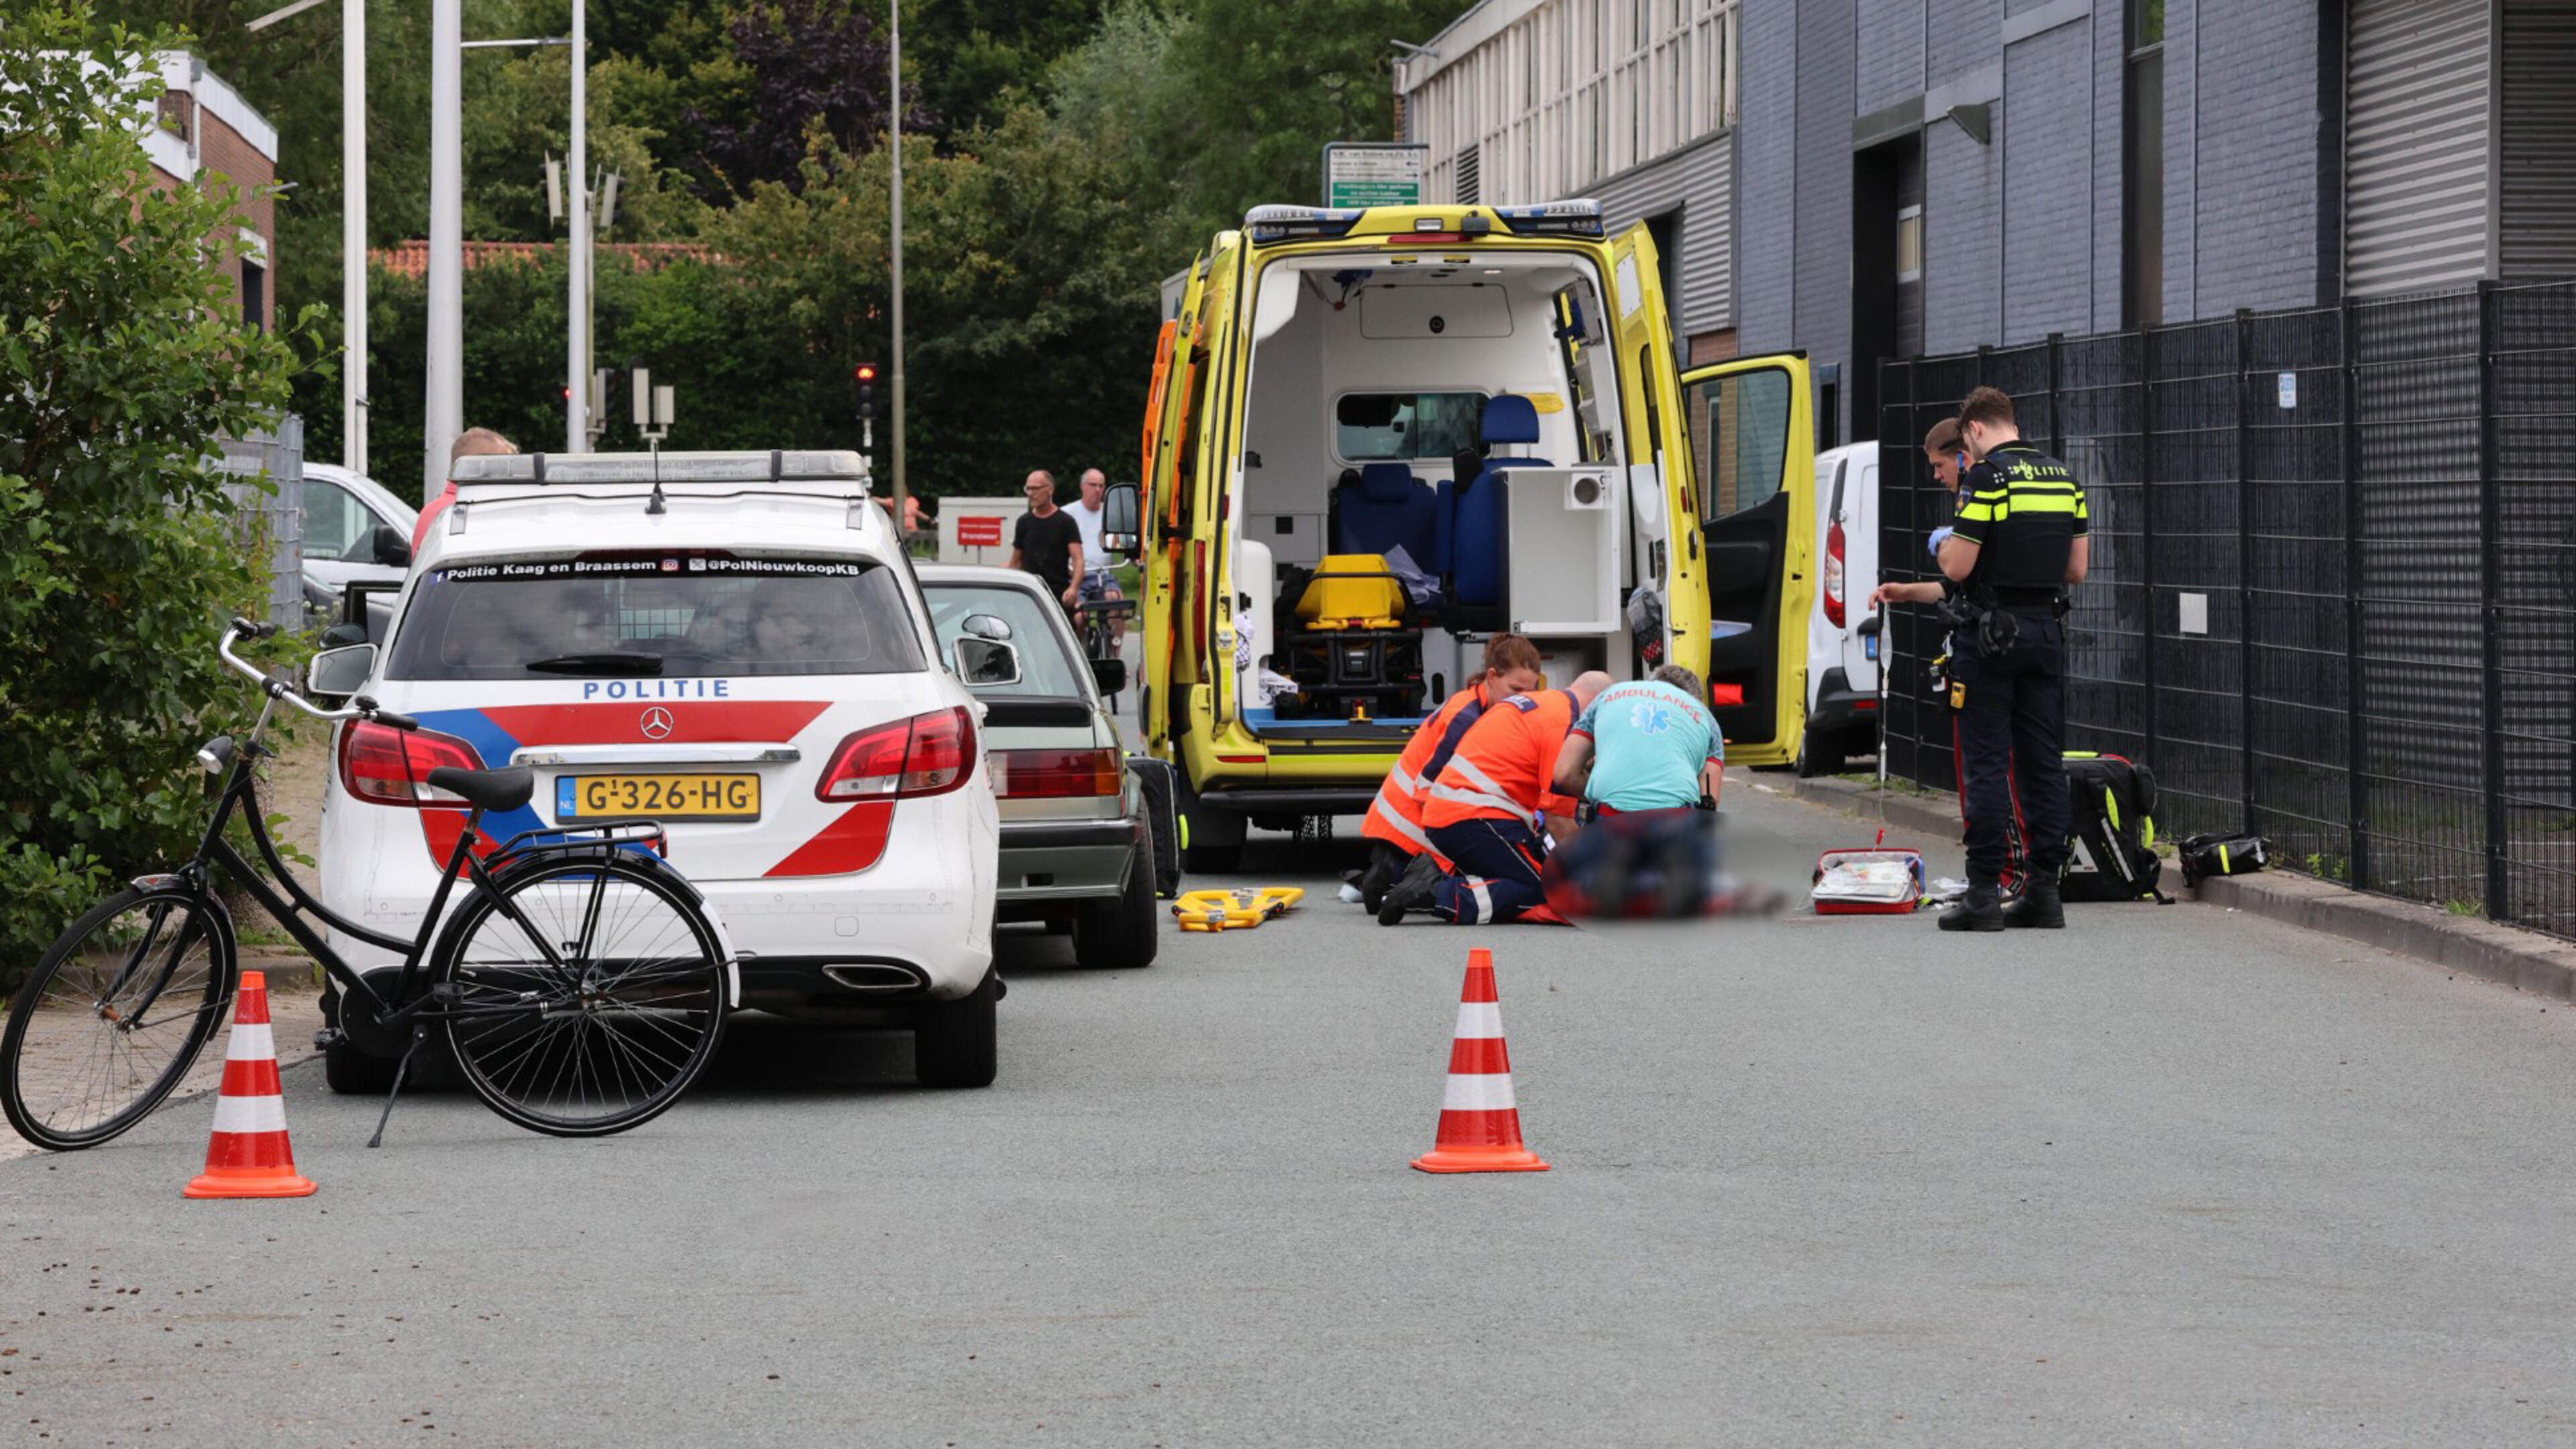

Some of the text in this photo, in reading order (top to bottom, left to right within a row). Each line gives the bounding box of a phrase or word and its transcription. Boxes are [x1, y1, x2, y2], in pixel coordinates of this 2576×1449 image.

[2012, 465, 2070, 480] POLITIE
[447, 566, 498, 580] Politie
[502, 564, 545, 576] Kaag
[549, 564, 570, 572] en
[574, 561, 656, 572] Braassem
[708, 560, 859, 576] @PolNieuwkoopKB
[584, 679, 729, 699] POLITIE
[1604, 688, 1702, 724] AMBULANCE
[560, 801, 573, 810] NL
